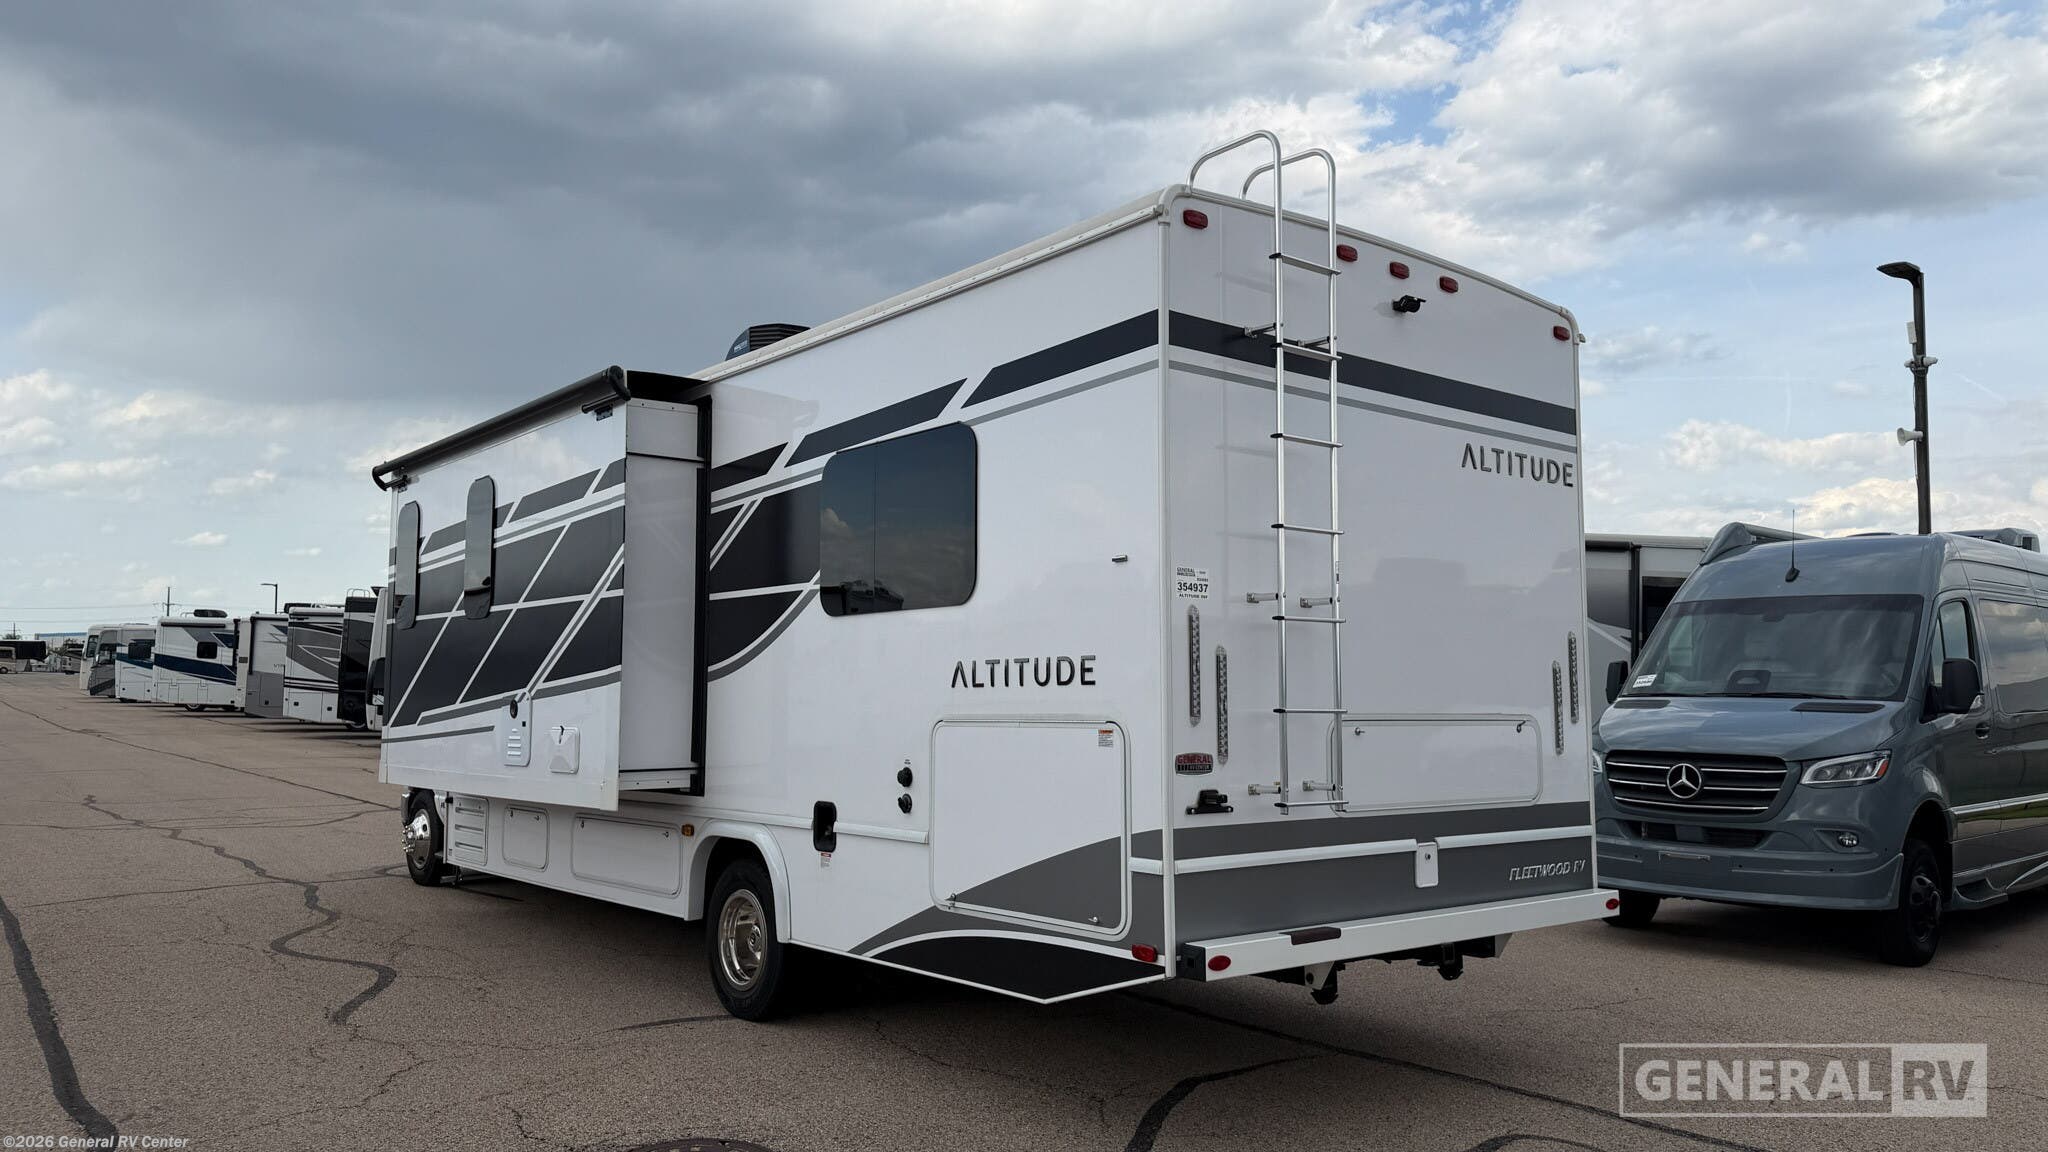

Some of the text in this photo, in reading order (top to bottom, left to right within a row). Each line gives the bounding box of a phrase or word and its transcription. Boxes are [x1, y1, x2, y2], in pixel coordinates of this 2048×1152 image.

[1461, 442, 1574, 488] ALTITUDE
[1177, 581, 1209, 593] 354937
[951, 655, 1096, 688] ALTITUDE
[1509, 861, 1571, 881] FLEETWOOD
